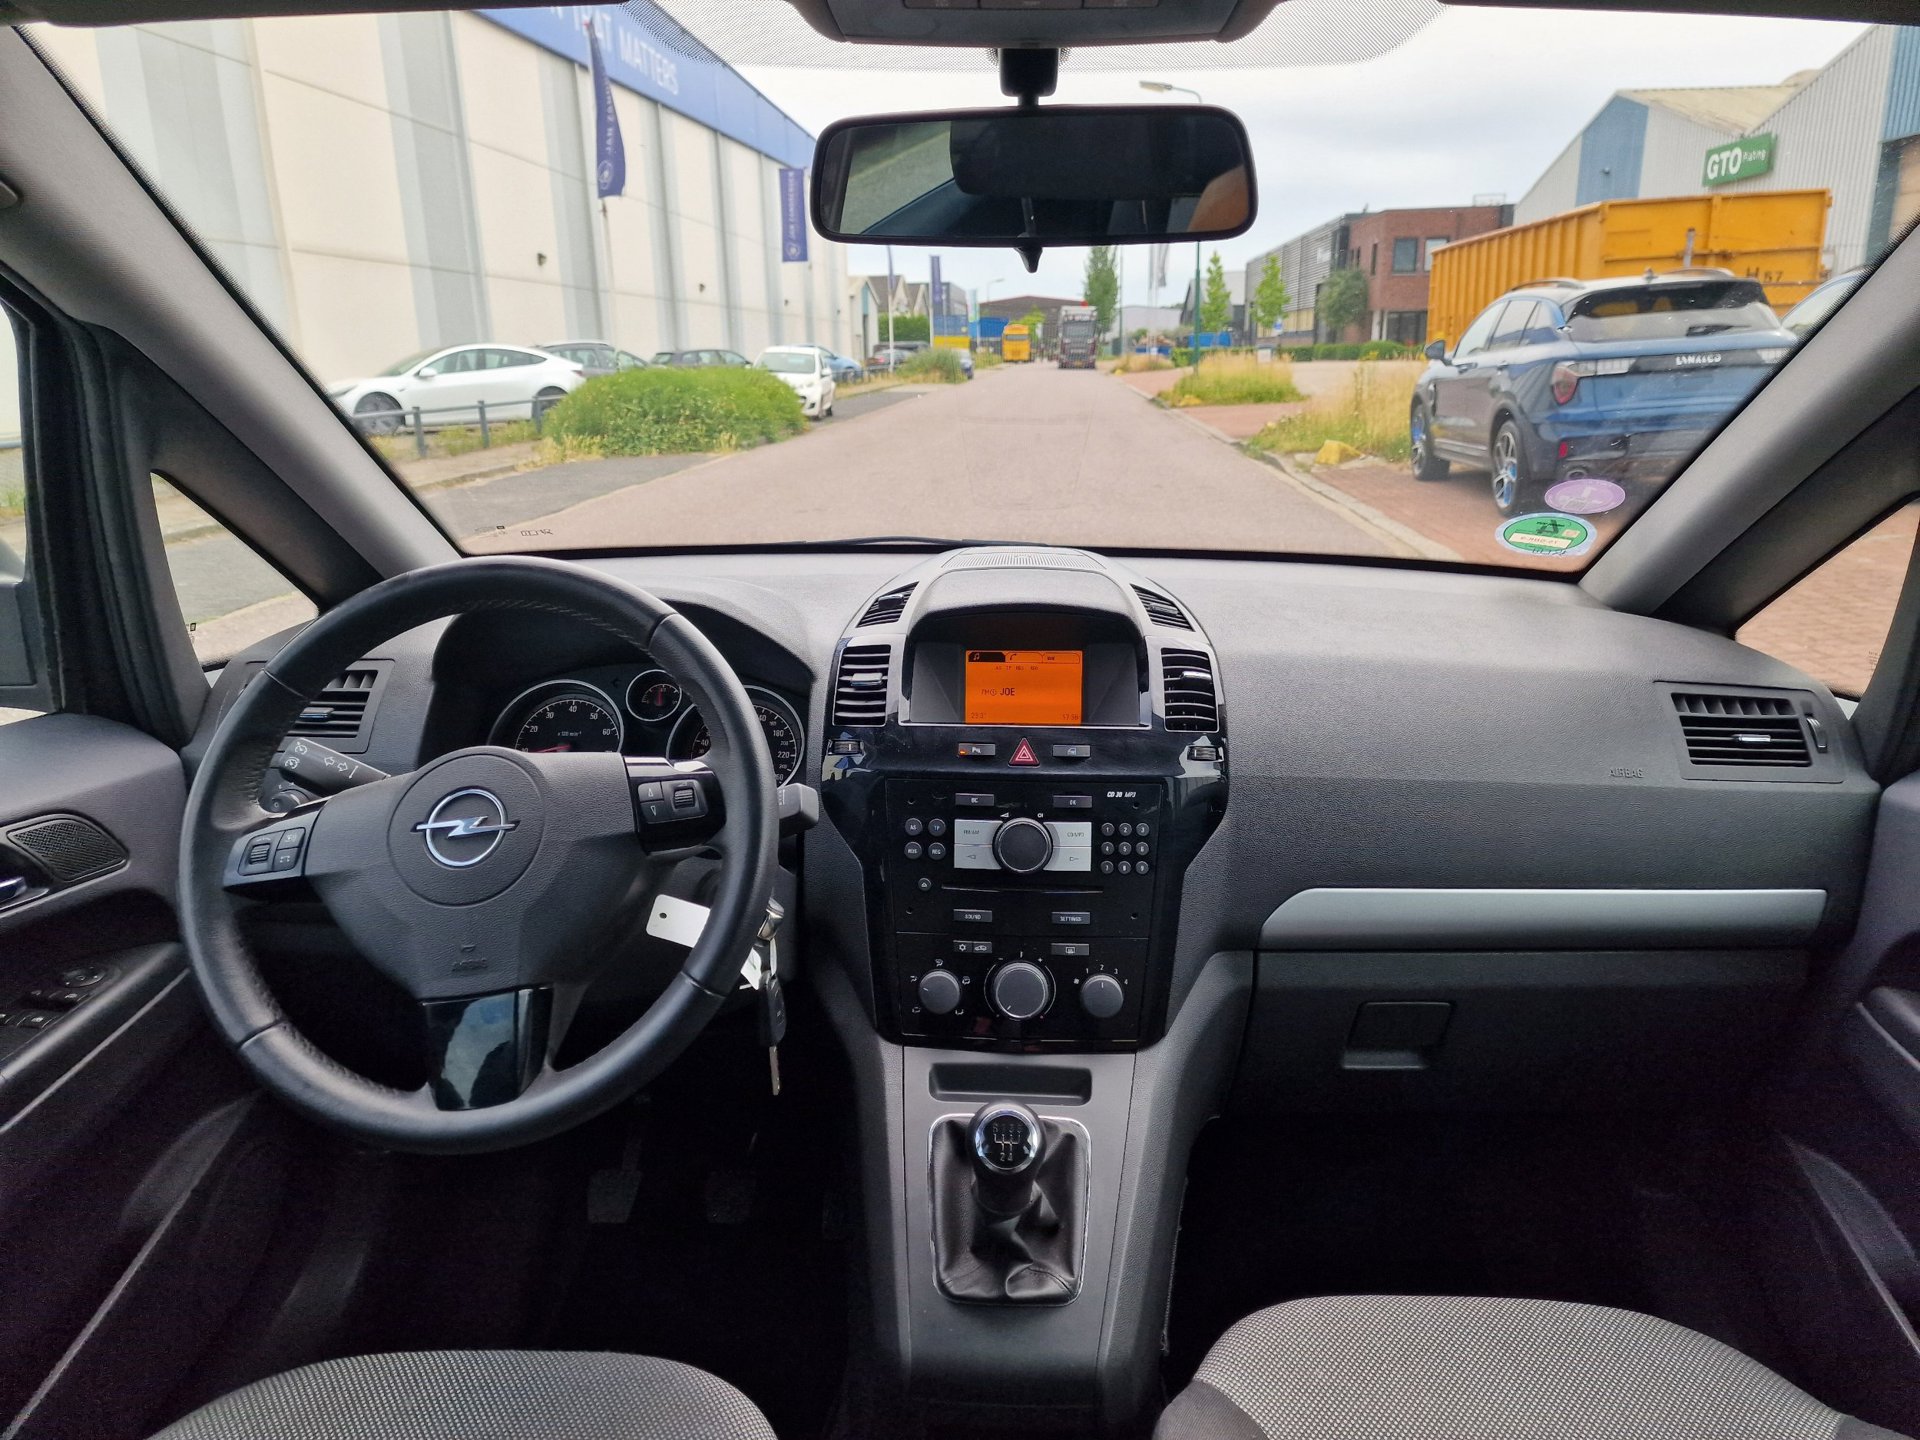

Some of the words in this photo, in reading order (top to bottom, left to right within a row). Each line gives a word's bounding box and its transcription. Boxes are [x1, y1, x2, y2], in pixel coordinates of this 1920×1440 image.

[619, 25, 679, 96] MATTERS
[1706, 146, 1742, 180] GTO
[999, 687, 1016, 697] JOE
[545, 711, 555, 719] 30
[589, 712, 598, 720] 50
[529, 725, 539, 733] 20
[602, 728, 611, 736] 60
[773, 729, 785, 738] 180
[700, 738, 710, 747] 40
[777, 751, 790, 759] 220
